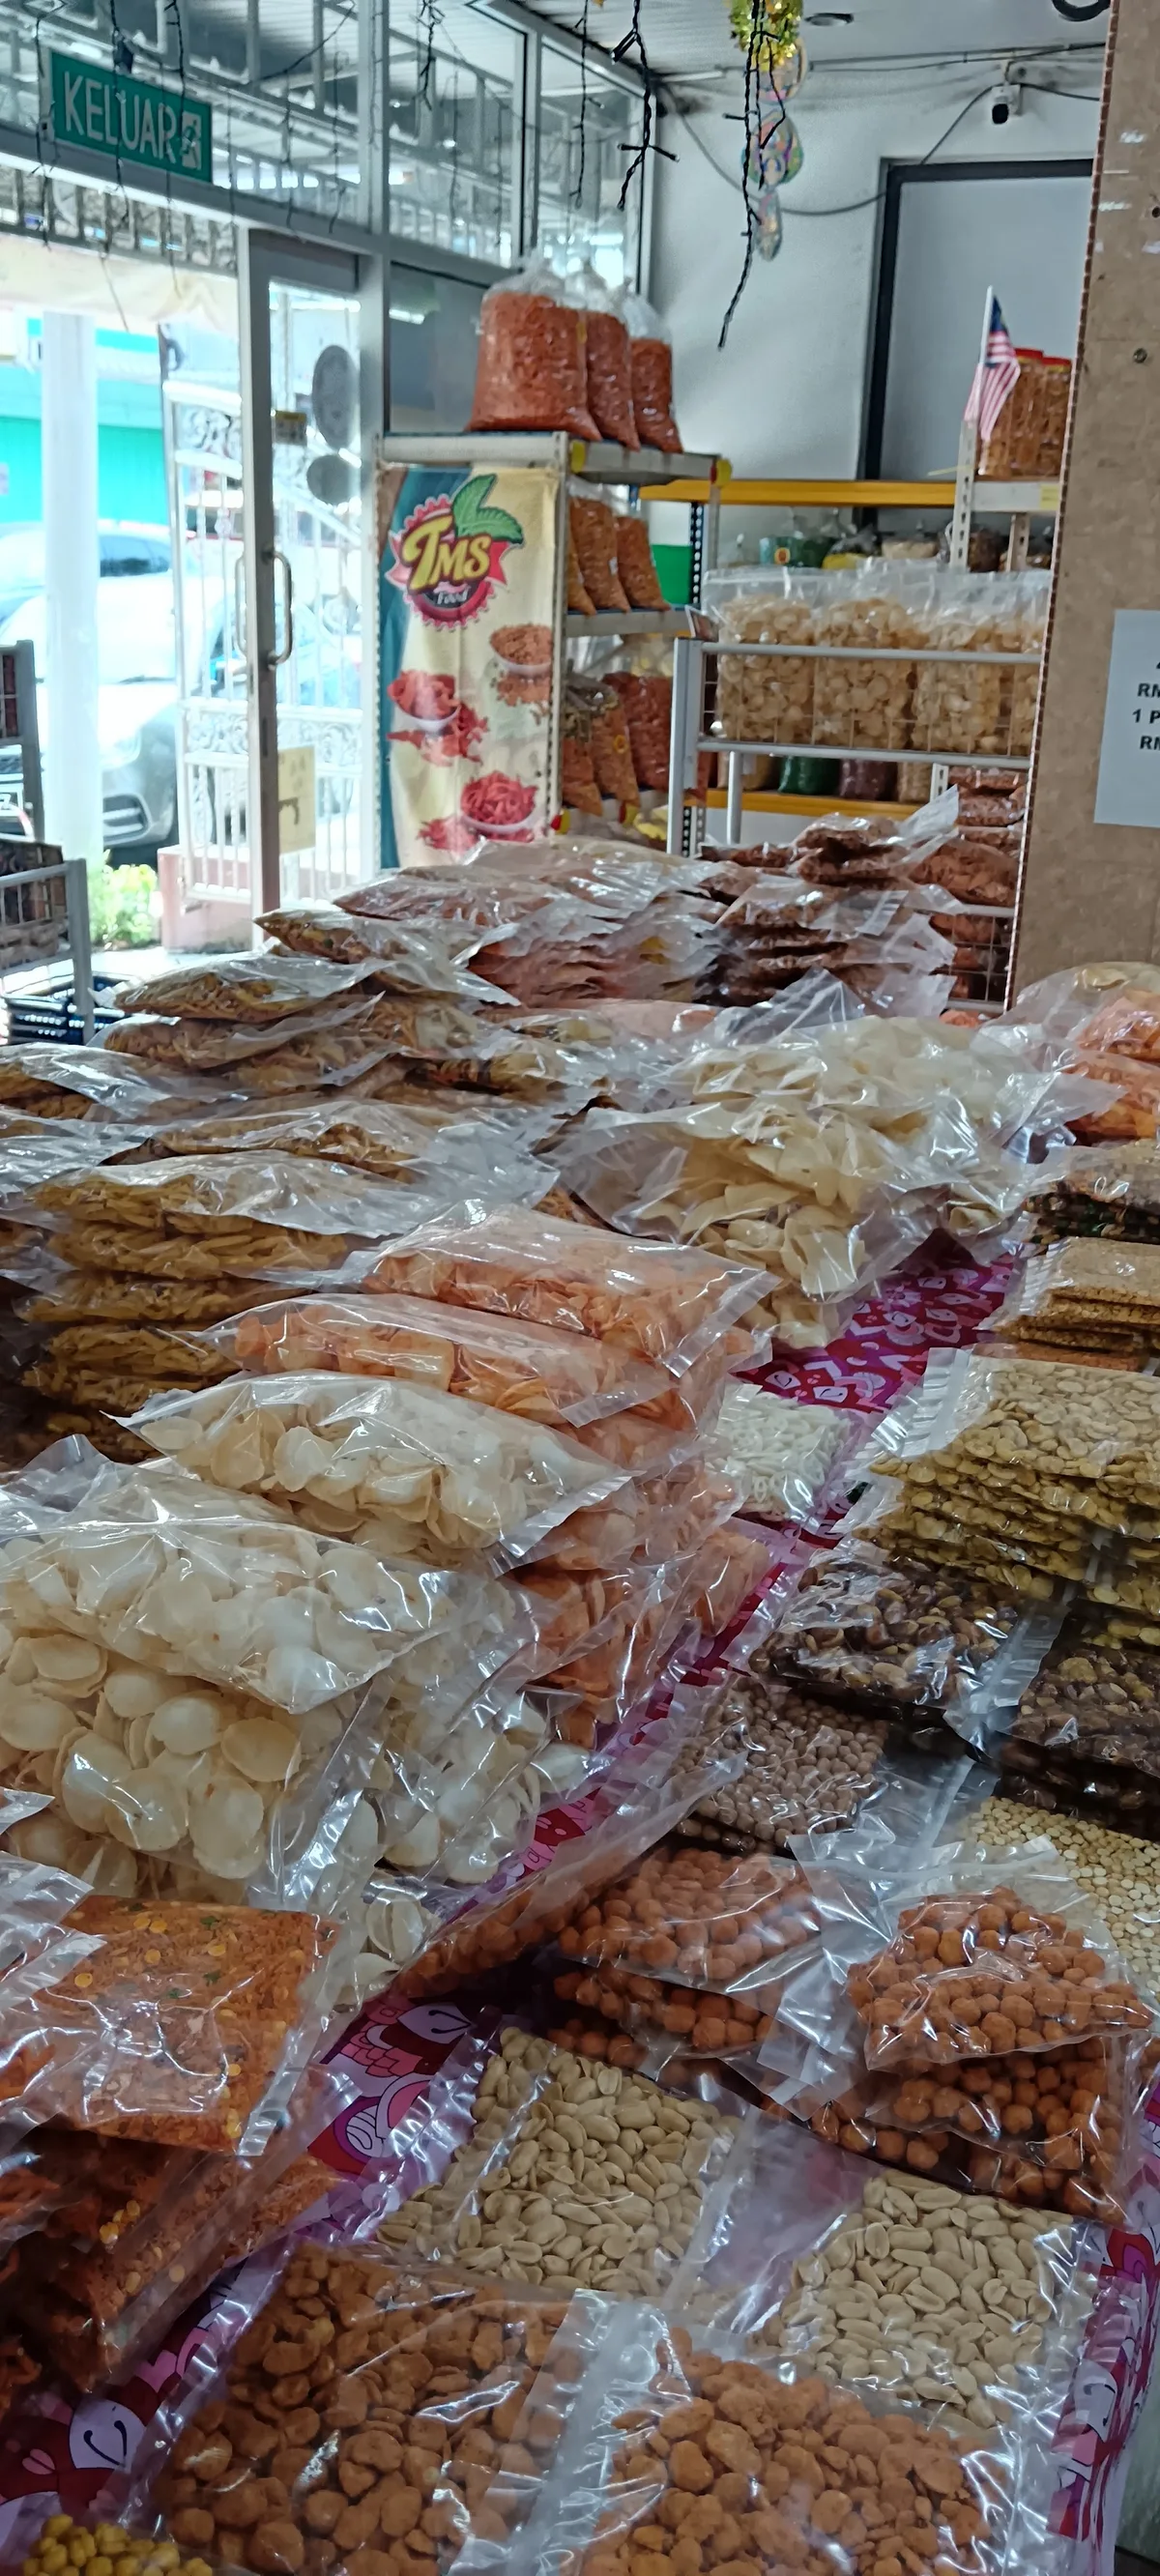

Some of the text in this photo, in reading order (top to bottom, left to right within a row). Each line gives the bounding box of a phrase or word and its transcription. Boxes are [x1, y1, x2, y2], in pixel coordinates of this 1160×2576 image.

[65, 71, 176, 164] KELUAR
[401, 514, 493, 591] TMS
[437, 587, 472, 605] Food
[1132, 708, 1142, 723] 1
